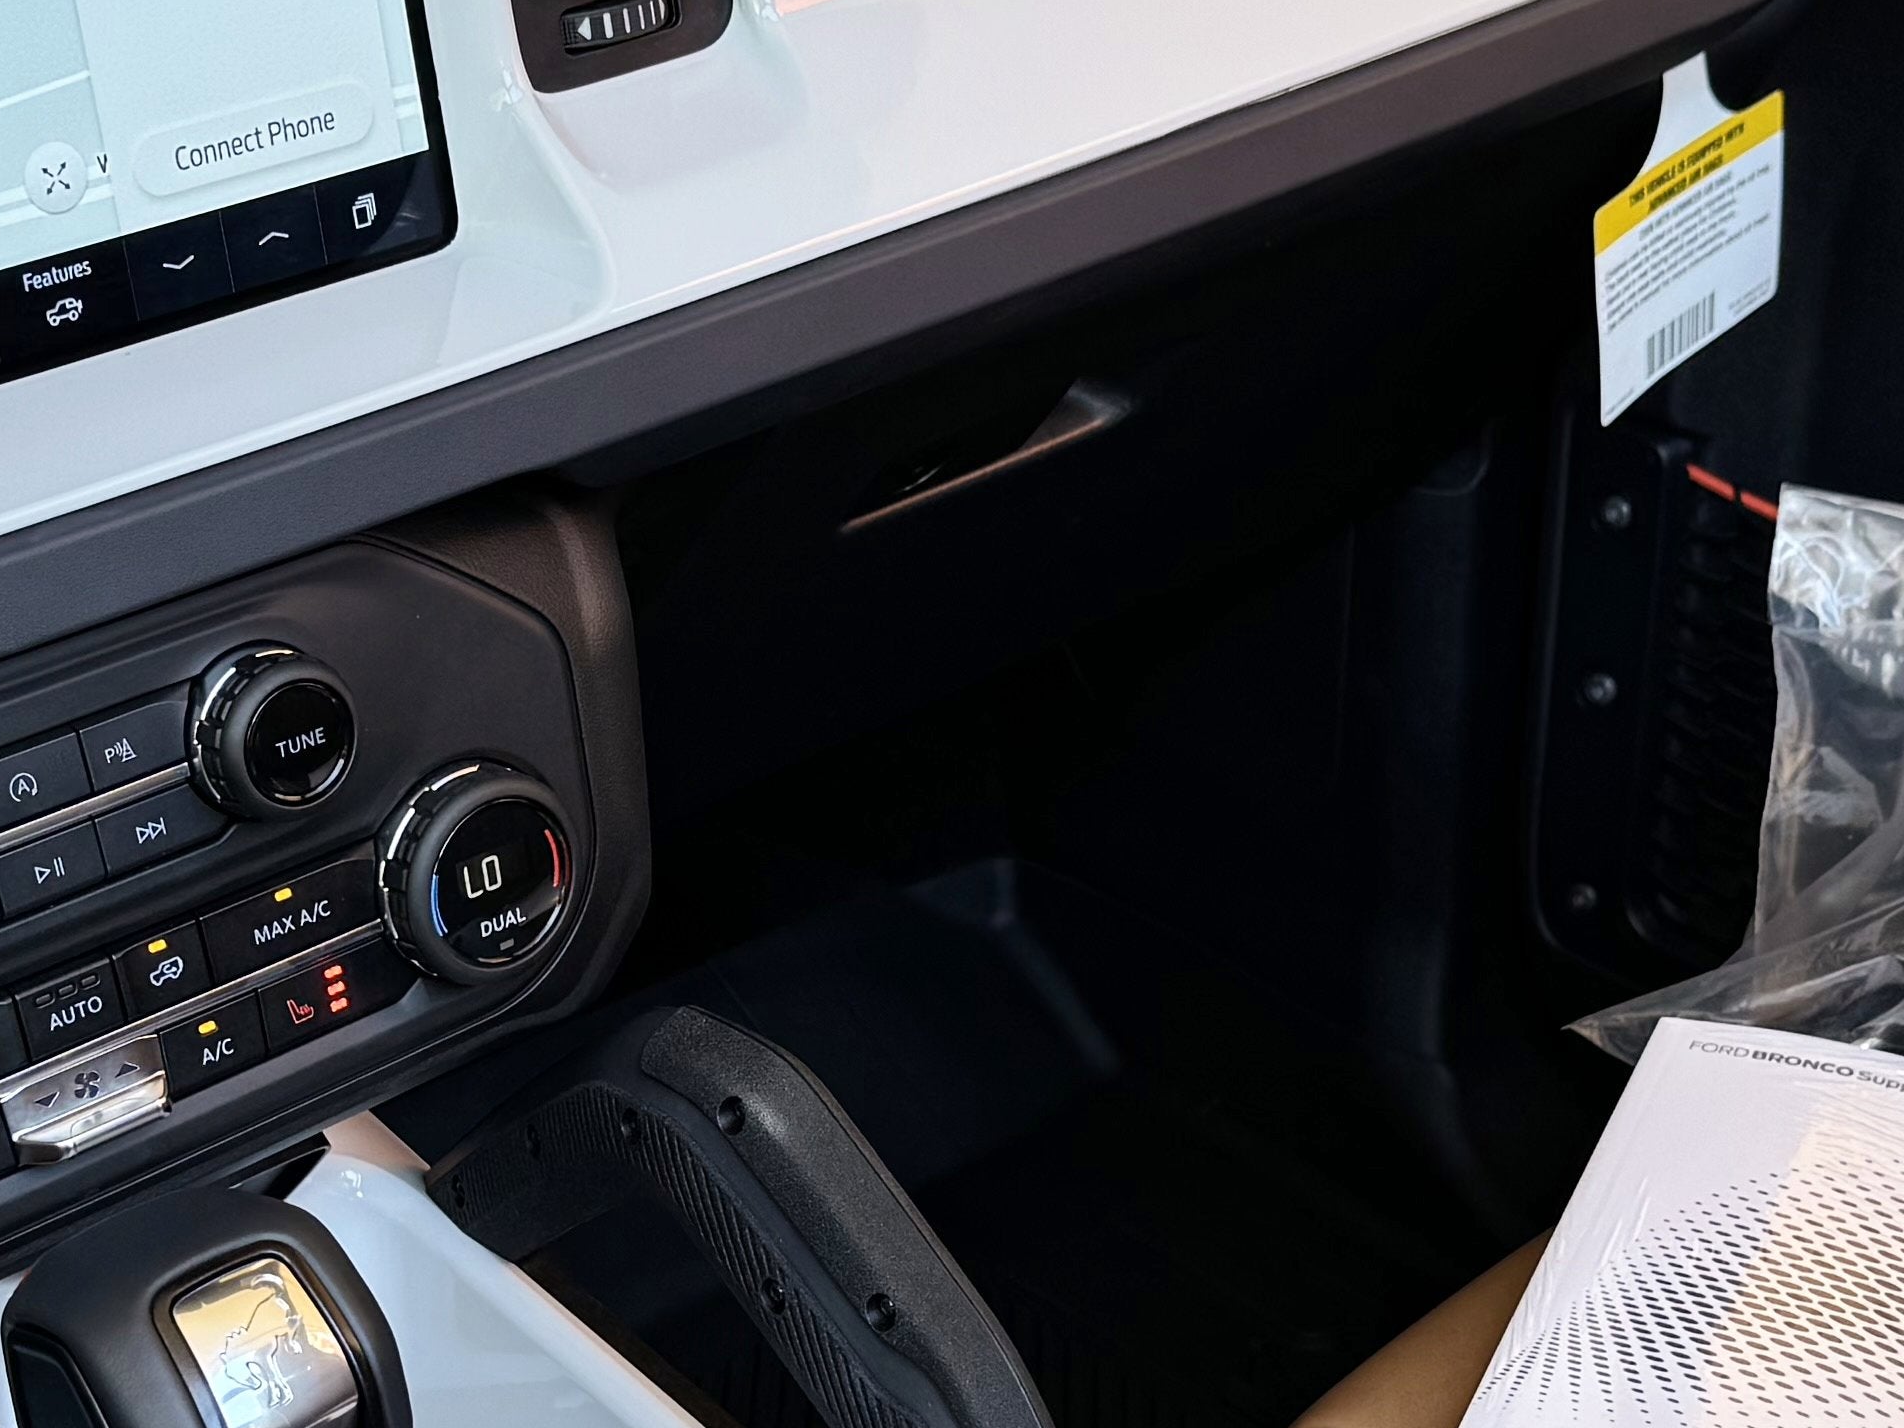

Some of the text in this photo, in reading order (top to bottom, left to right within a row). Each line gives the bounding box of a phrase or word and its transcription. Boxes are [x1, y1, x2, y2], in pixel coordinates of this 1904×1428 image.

[174, 108, 336, 172] Connect Phone
[22, 256, 93, 293] Features
[274, 725, 329, 759] TUNE
[253, 898, 332, 945] MAX A/C
[479, 904, 528, 938] DUAL
[48, 994, 104, 1033] AUTO
[201, 1035, 236, 1068] A/C
[1687, 1039, 1750, 1060] FORD
[1751, 1049, 1855, 1078] BRONCO
